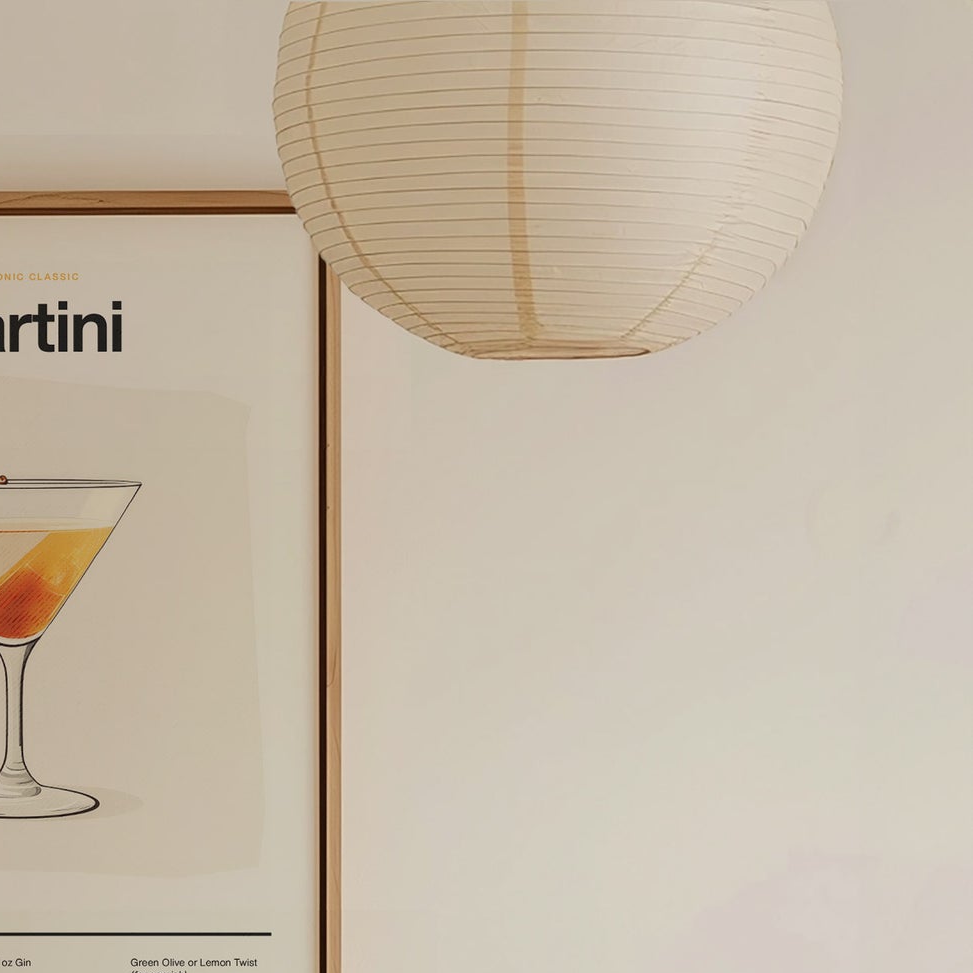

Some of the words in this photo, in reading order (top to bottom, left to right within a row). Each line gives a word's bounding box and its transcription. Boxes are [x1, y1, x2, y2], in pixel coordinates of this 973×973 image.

[15, 958, 32, 967] Gin
[130, 958, 159, 967] Green
[161, 958, 185, 968] Olive
[199, 959, 232, 967] Lemon
[233, 958, 258, 967] Twist
